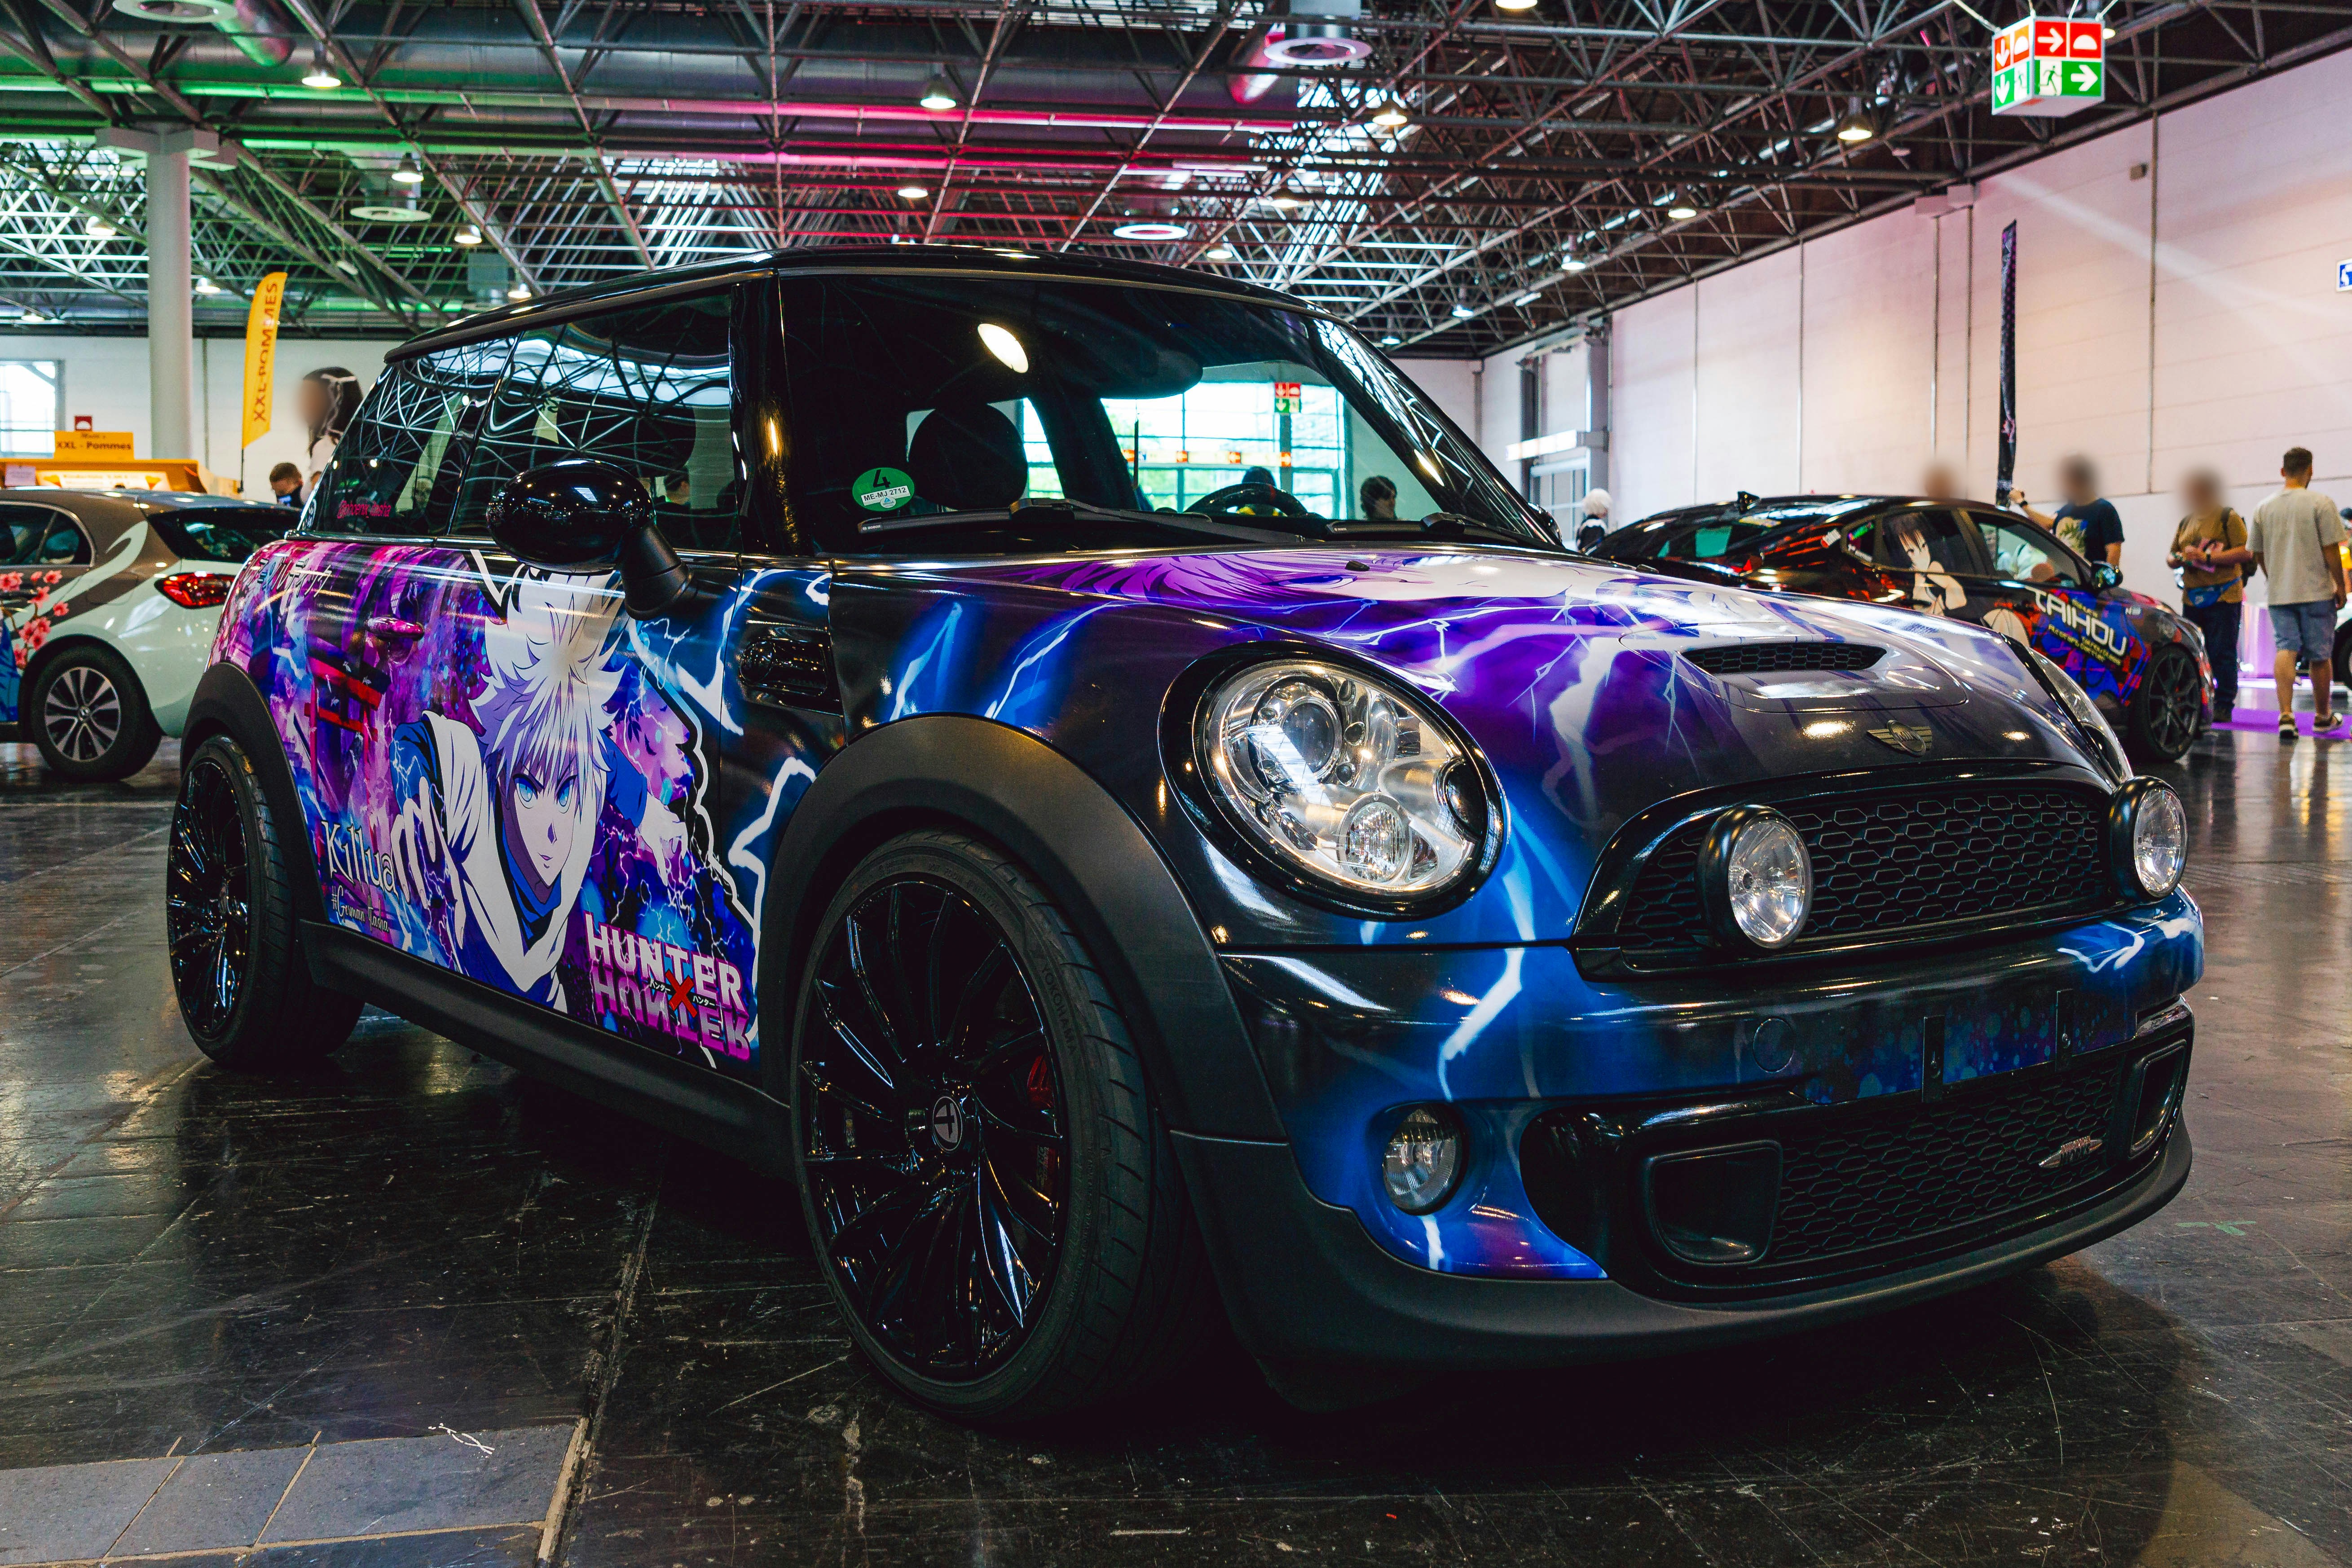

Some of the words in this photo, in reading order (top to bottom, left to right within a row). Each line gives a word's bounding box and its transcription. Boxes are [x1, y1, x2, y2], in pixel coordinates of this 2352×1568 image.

[57, 441, 76, 449] XXL
[87, 441, 131, 449] Pommes
[864, 491, 888, 501] ME-MJ
[890, 487, 906, 496] 2712
[872, 469, 891, 488] 4
[2024, 585, 2127, 656] TAIHOU
[321, 821, 400, 904] Killua
[331, 885, 365, 922] #German
[584, 910, 749, 1017] HUNTER
[693, 995, 715, 1007] ハンター
[1042, 966, 1077, 1051] YOKOHAMA
